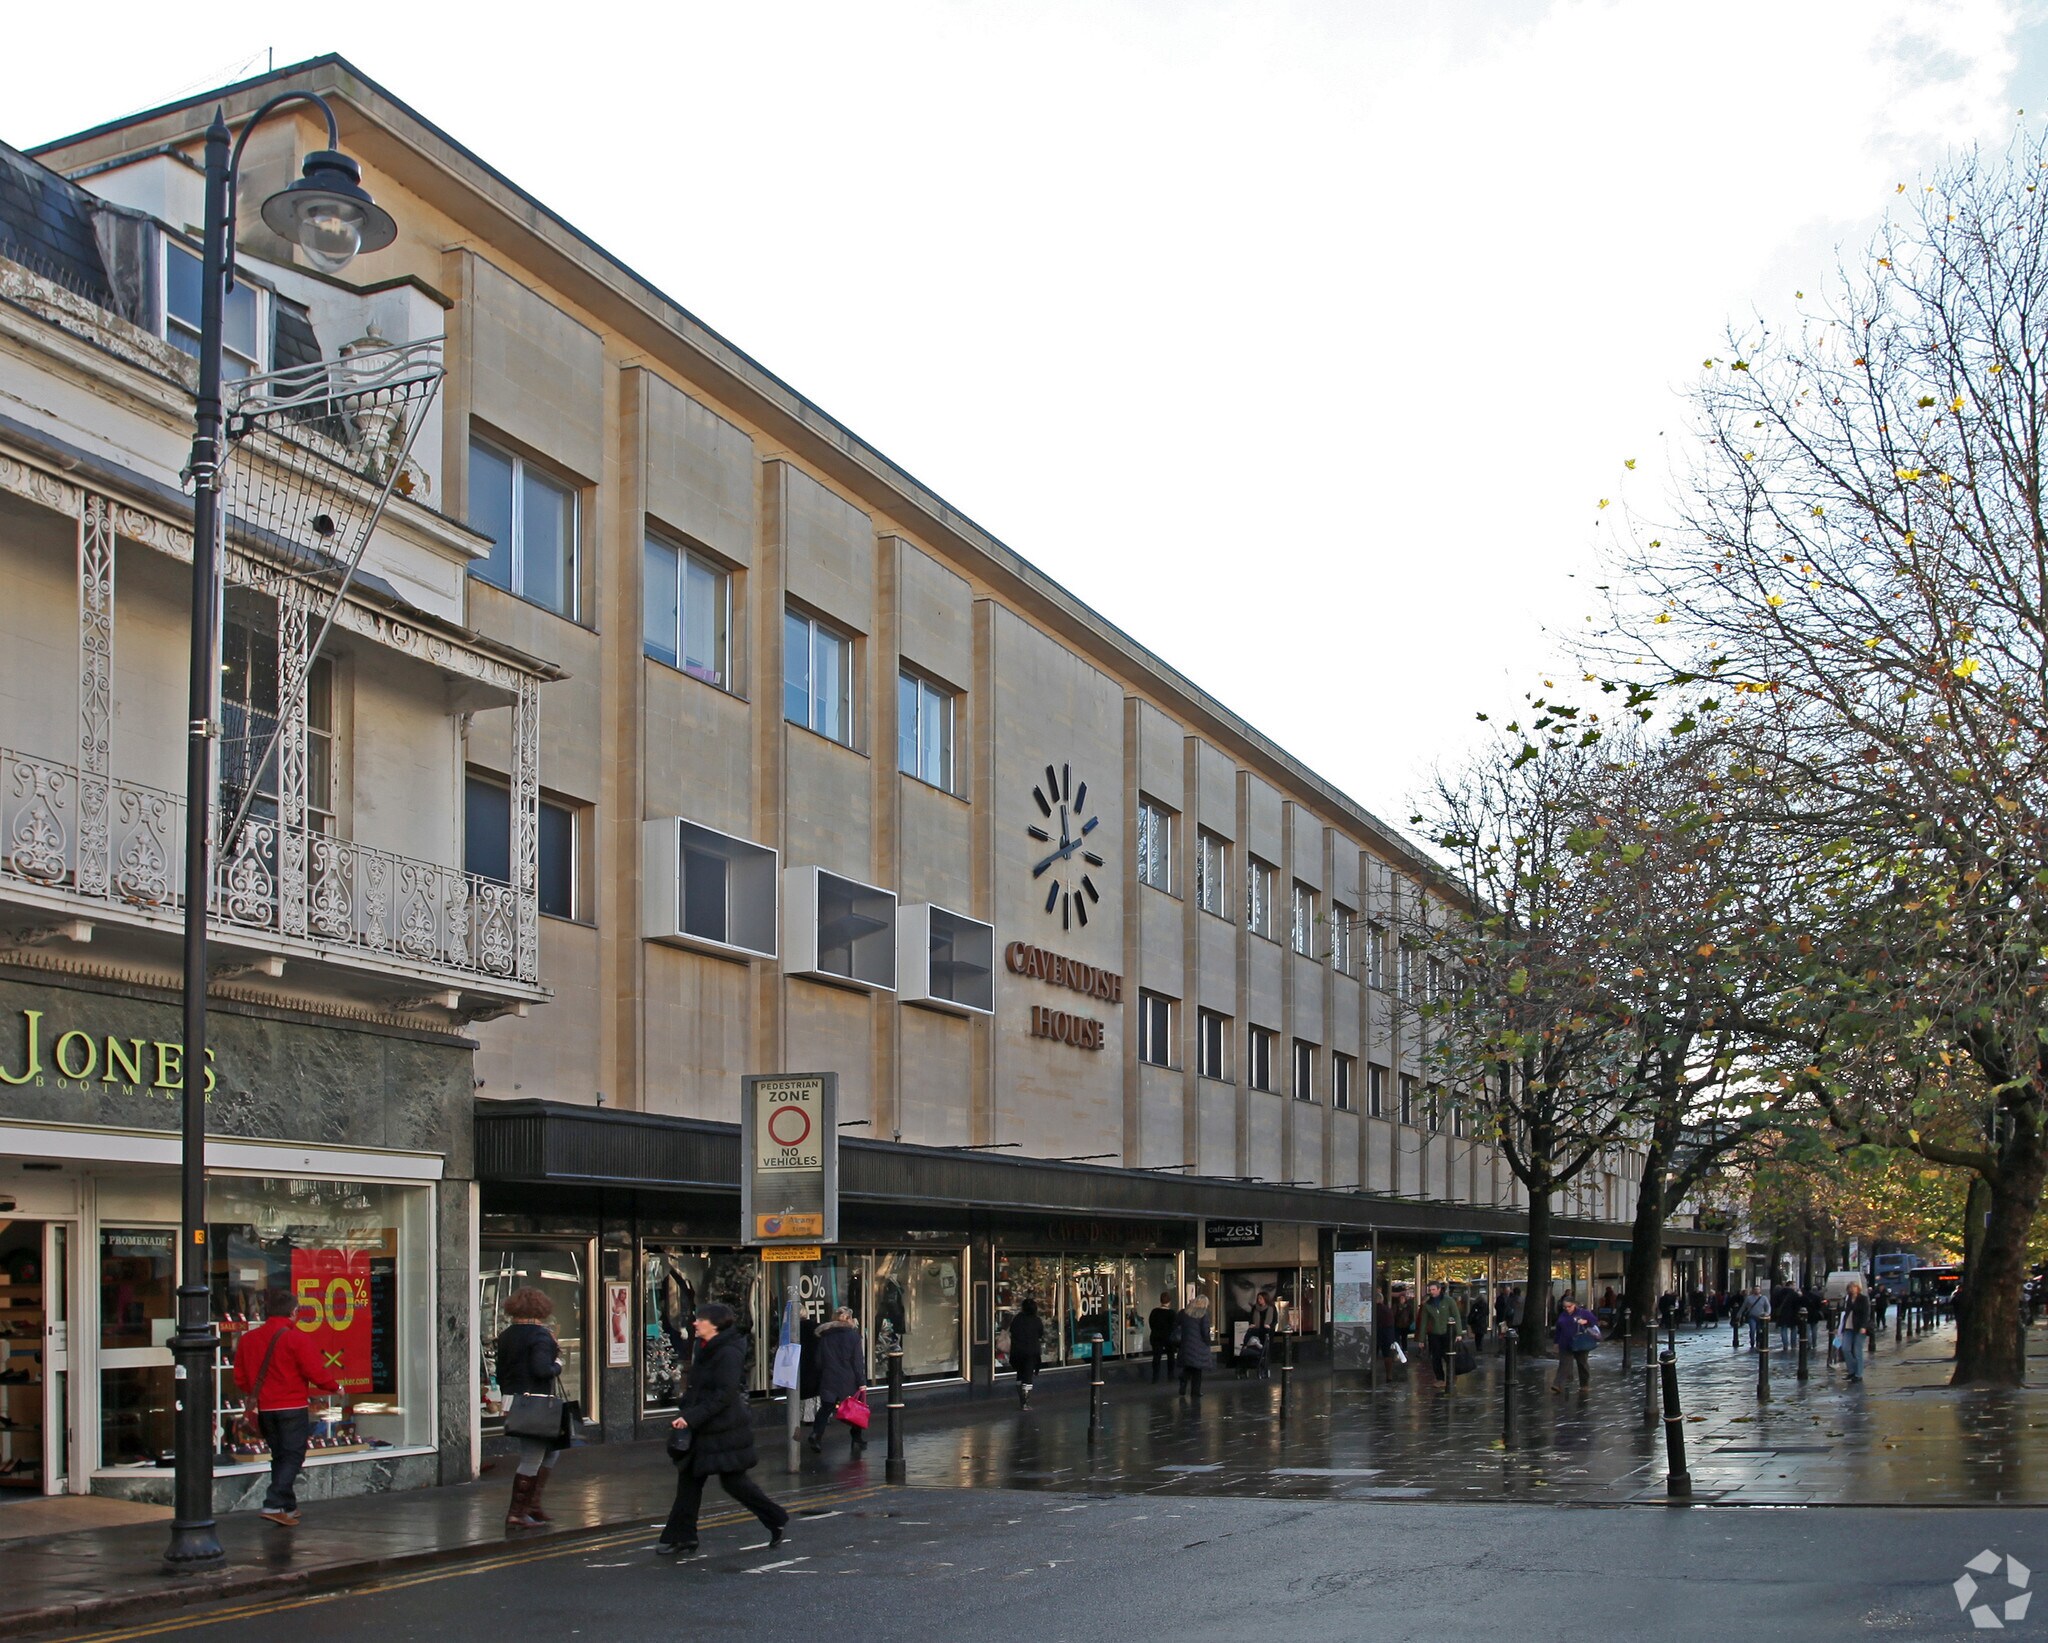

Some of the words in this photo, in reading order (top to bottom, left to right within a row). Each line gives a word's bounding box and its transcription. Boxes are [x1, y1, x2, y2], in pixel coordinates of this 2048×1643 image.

[1005, 941, 1125, 1004] CAVENDISH
[1031, 1005, 1105, 1051] HOUSE
[36, 1076, 212, 1104] BOOTMAKR
[760, 1081, 818, 1090] PEDESTRIAN
[769, 1090, 810, 1102] ZONE
[763, 1156, 817, 1167] VEHICLES
[782, 1148, 798, 1157] NO
[1226, 1223, 1260, 1237] zest
[109, 1235, 167, 1246] PROMENADE
[800, 1275, 826, 1299] 0%
[1079, 1276, 1103, 1295] 40%
[296, 1278, 367, 1333] 50%
[354, 1299, 369, 1307] OFF
[804, 1301, 825, 1323] FF
[1081, 1297, 1102, 1316] OFF
